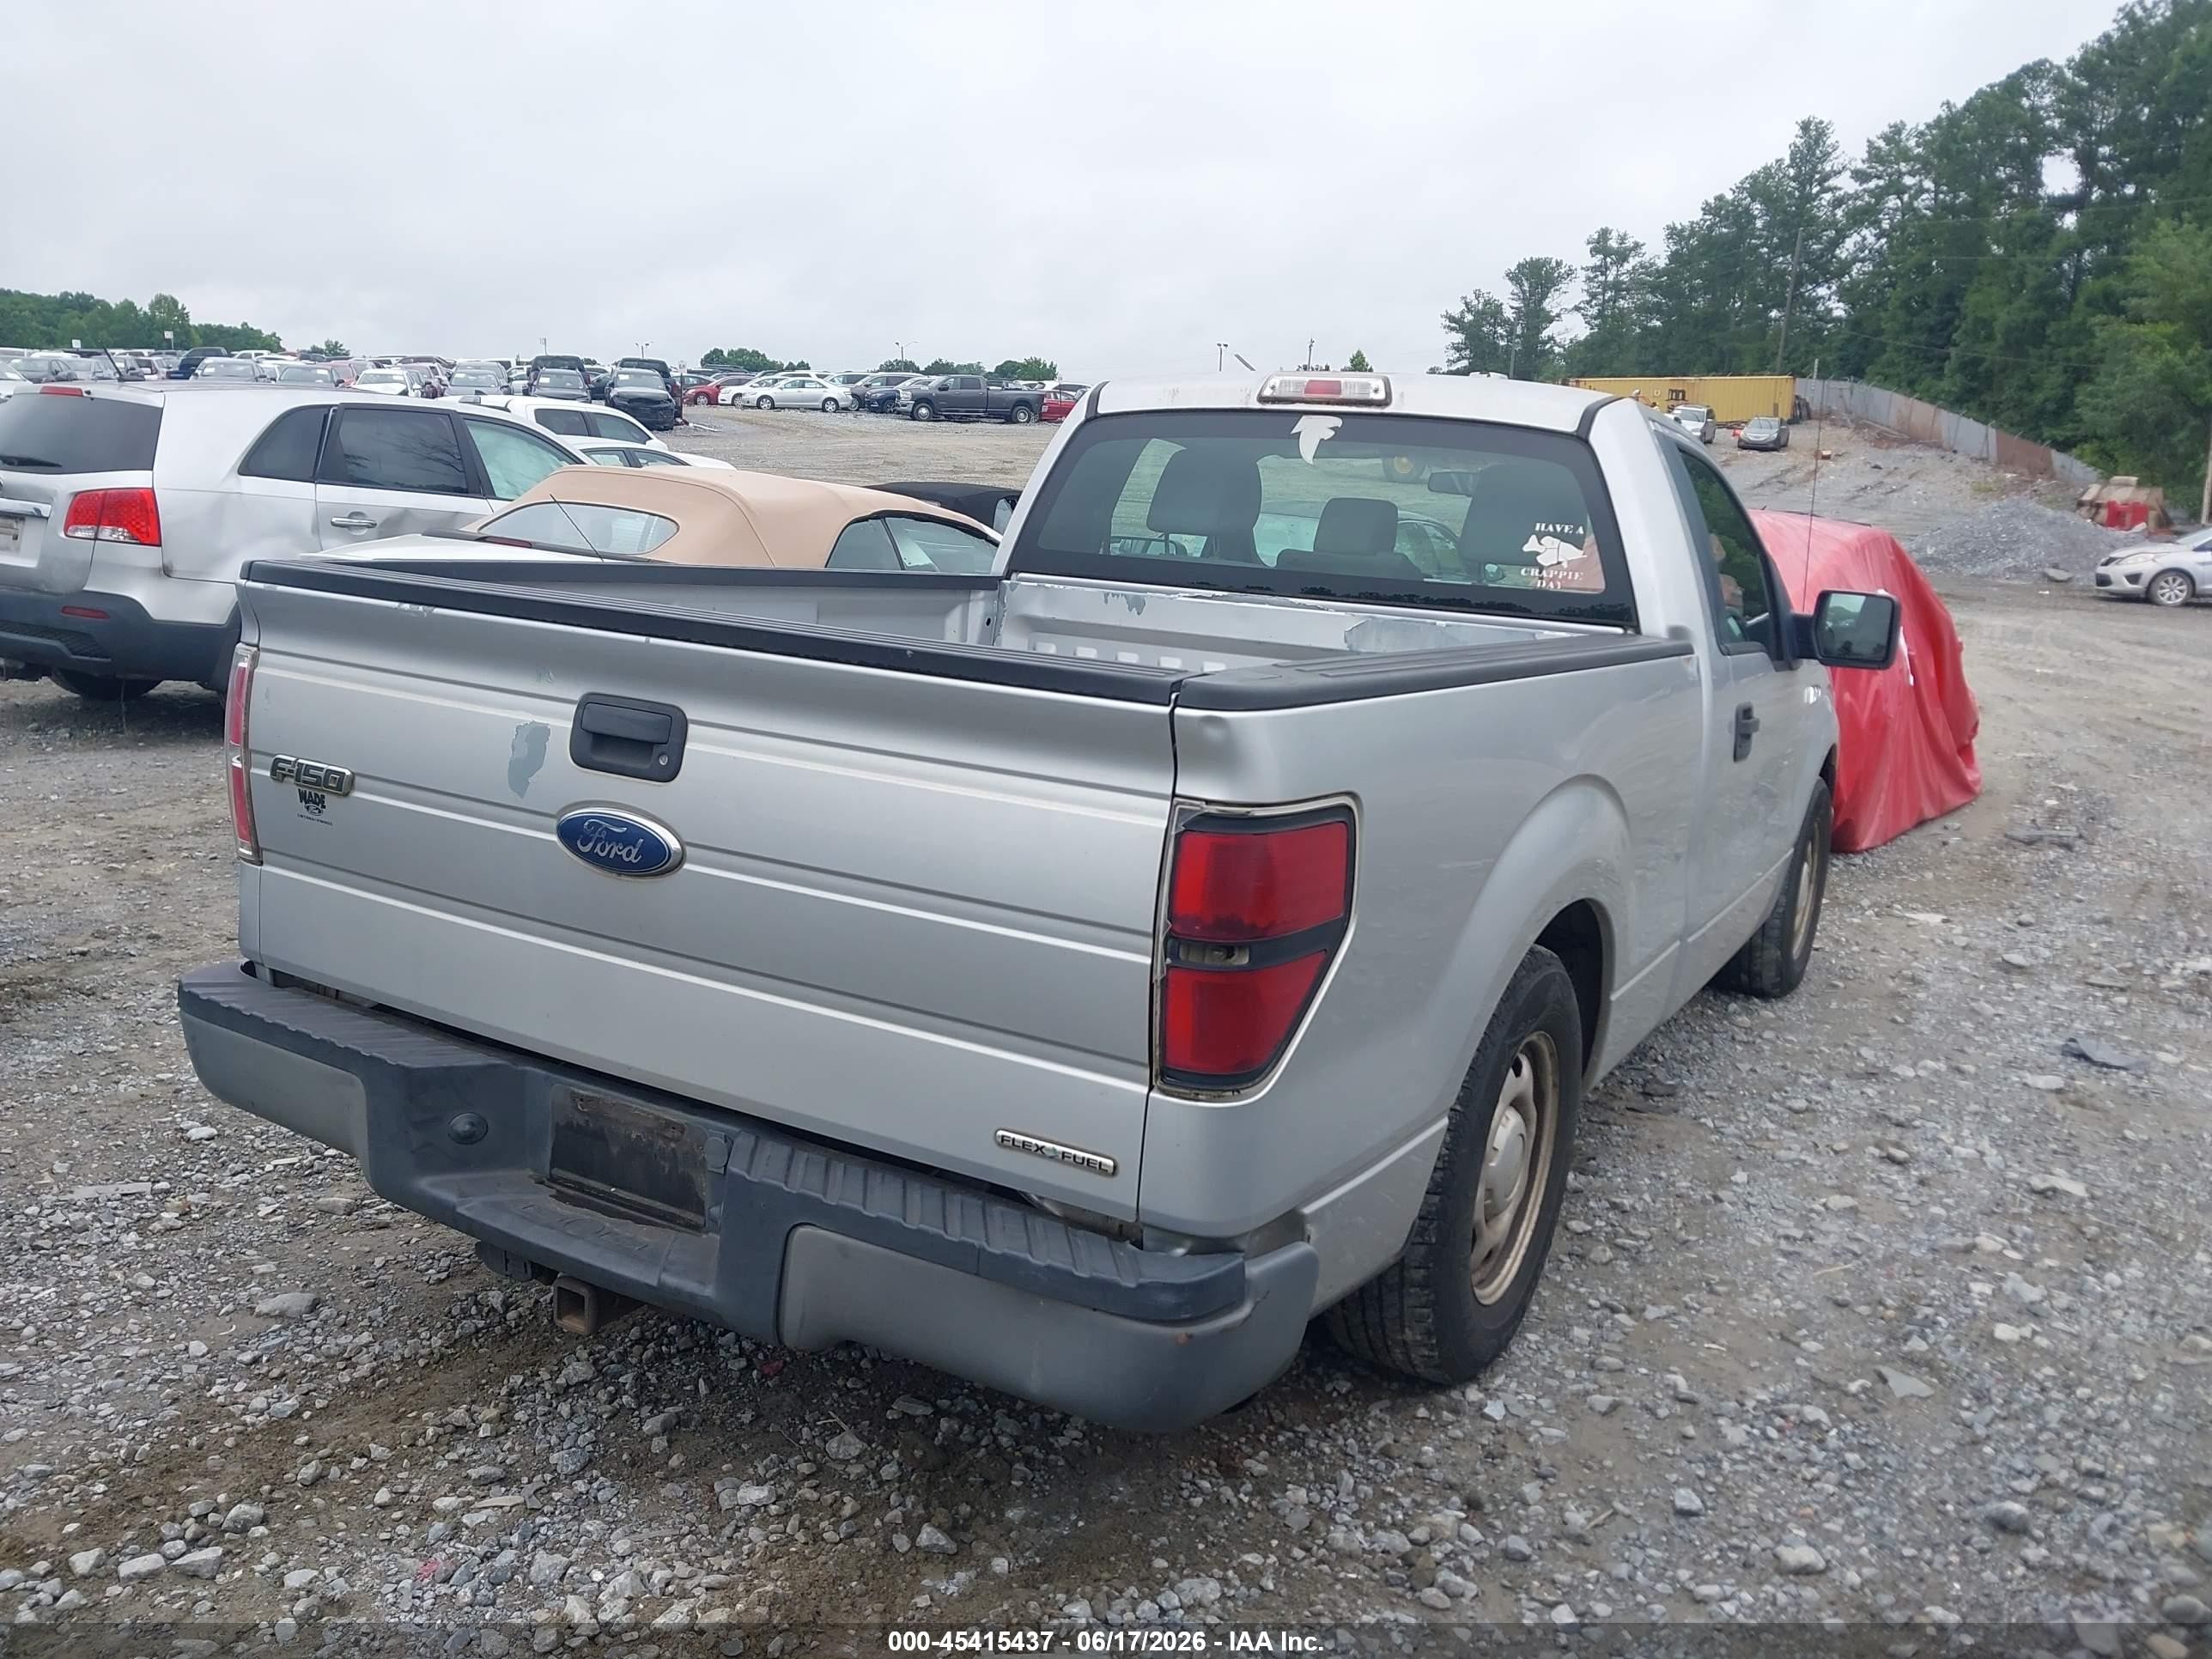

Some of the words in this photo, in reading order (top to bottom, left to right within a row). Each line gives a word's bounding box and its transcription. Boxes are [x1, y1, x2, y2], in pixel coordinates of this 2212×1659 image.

[1534, 522, 1574, 534] HAVE
[1575, 526, 1584, 534] A
[1521, 568, 1584, 581] CRAPPIE
[297, 787, 326, 810] WADE
[576, 818, 644, 864] Ford
[1000, 1133, 1046, 1155] FLEX
[1060, 1151, 1110, 1173] FUEL
